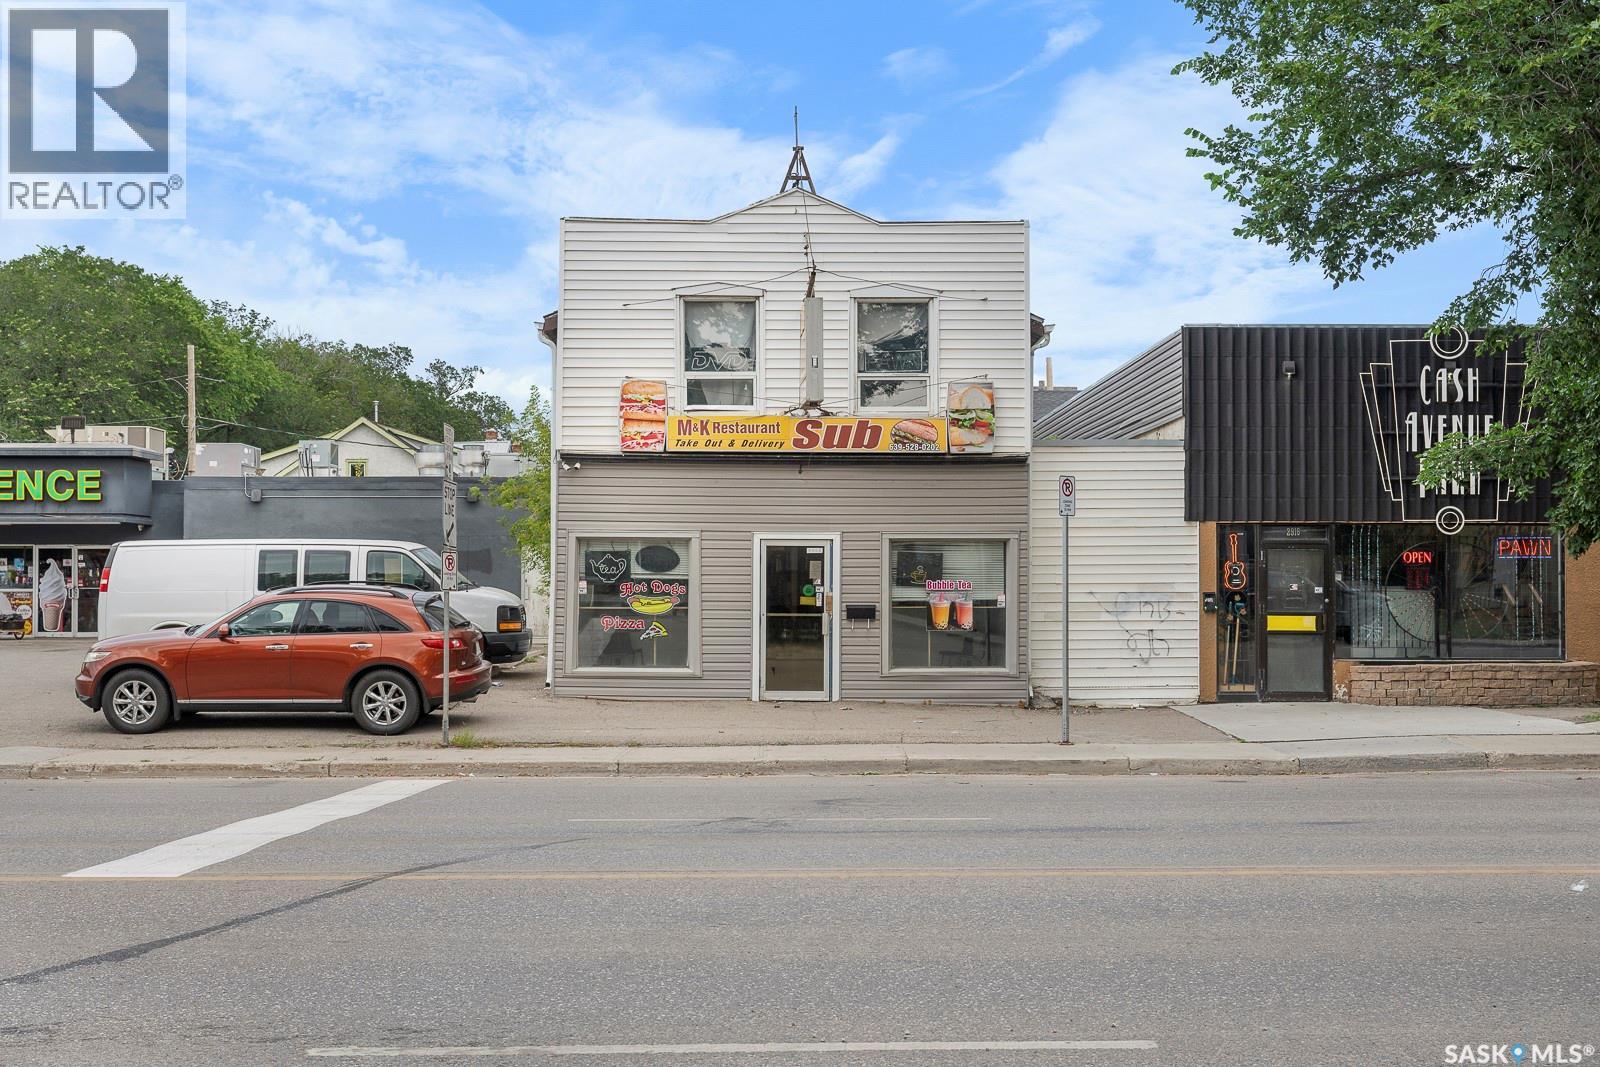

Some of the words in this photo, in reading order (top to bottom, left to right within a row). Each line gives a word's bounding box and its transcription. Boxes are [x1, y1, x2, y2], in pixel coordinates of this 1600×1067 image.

[691, 350, 748, 371] DVD
[1420, 365, 1479, 405] CASH
[677, 419, 710, 436] M&K
[712, 421, 781, 434] Restaurant
[792, 419, 883, 450] Sub
[675, 439, 699, 448] Take
[704, 439, 723, 448] Out
[728, 439, 736, 448] &
[741, 439, 785, 449] Delivery
[889, 443, 940, 451] 639-528-0202
[444, 486, 456, 499] STOP
[444, 503, 455, 517] LINE
[1499, 540, 1551, 556] PAWN
[1402, 551, 1432, 564] OPEN
[620, 581, 648, 597] Hot
[651, 580, 687, 596] Dogs
[926, 580, 955, 591] Bubble
[957, 579, 973, 591] Tea
[600, 615, 646, 632] Pizza
